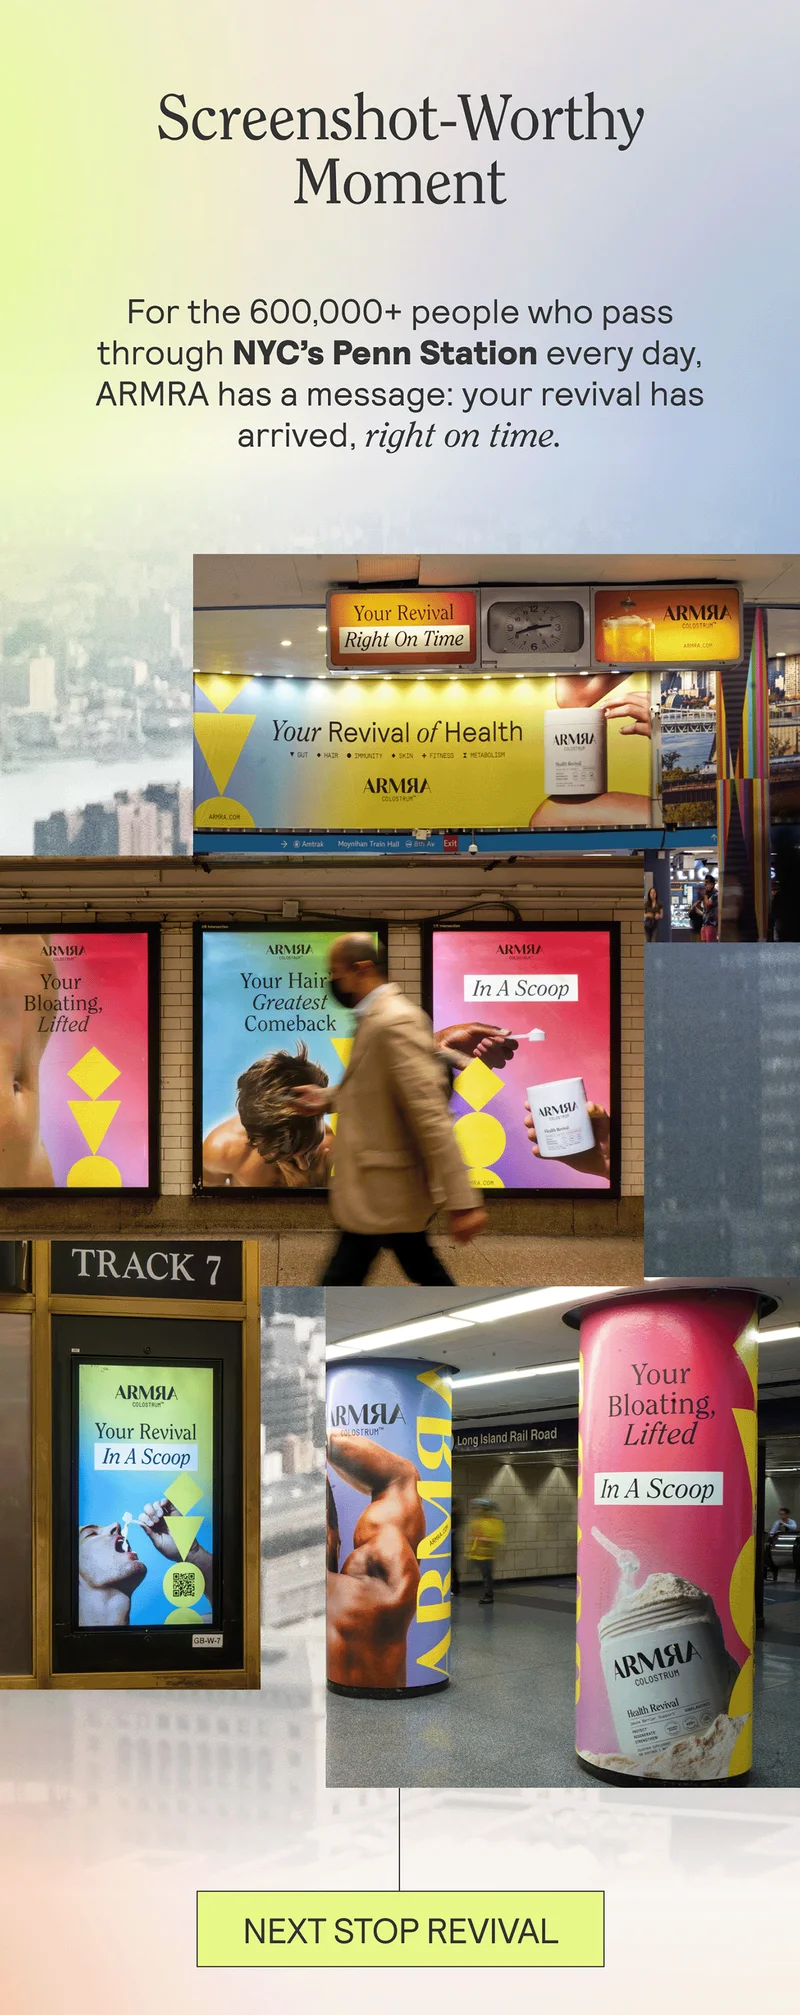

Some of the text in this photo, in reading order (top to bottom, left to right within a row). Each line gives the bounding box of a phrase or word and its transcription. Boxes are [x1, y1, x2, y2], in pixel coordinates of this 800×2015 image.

[354, 603, 453, 621] Your Revival
[530, 605, 538, 613] 12
[507, 624, 514, 632] 9
[344, 630, 464, 651] Right On Time
[272, 719, 523, 744] Your Revival of Health
[208, 813, 241, 821] ARMRA.COM
[301, 840, 324, 848] Amtrak
[338, 840, 400, 849] Moynihan Train Hall
[443, 839, 458, 848] Exit
[40, 973, 82, 990] Your
[240, 972, 282, 989] Your
[472, 979, 570, 999] In A Scoop
[24, 994, 103, 1014] Bloating,
[252, 994, 328, 1011] Greatest
[37, 1015, 90, 1033] Lifted
[244, 1014, 337, 1032] Comeback
[71, 1248, 221, 1285] TRACK 7
[631, 1363, 691, 1386] Your
[608, 1391, 715, 1420] Bloating,
[95, 1422, 196, 1440] Your Revival
[457, 1427, 557, 1448] Long Island Rail Road
[623, 1420, 698, 1446] Lifted
[102, 1447, 191, 1469] In A Scoop
[600, 1477, 715, 1503] In A Scoop
[193, 1637, 221, 1645] GB-W-7
[634, 1669, 680, 1687] COLOSTRUM
[626, 1698, 680, 1718] Health Revival
